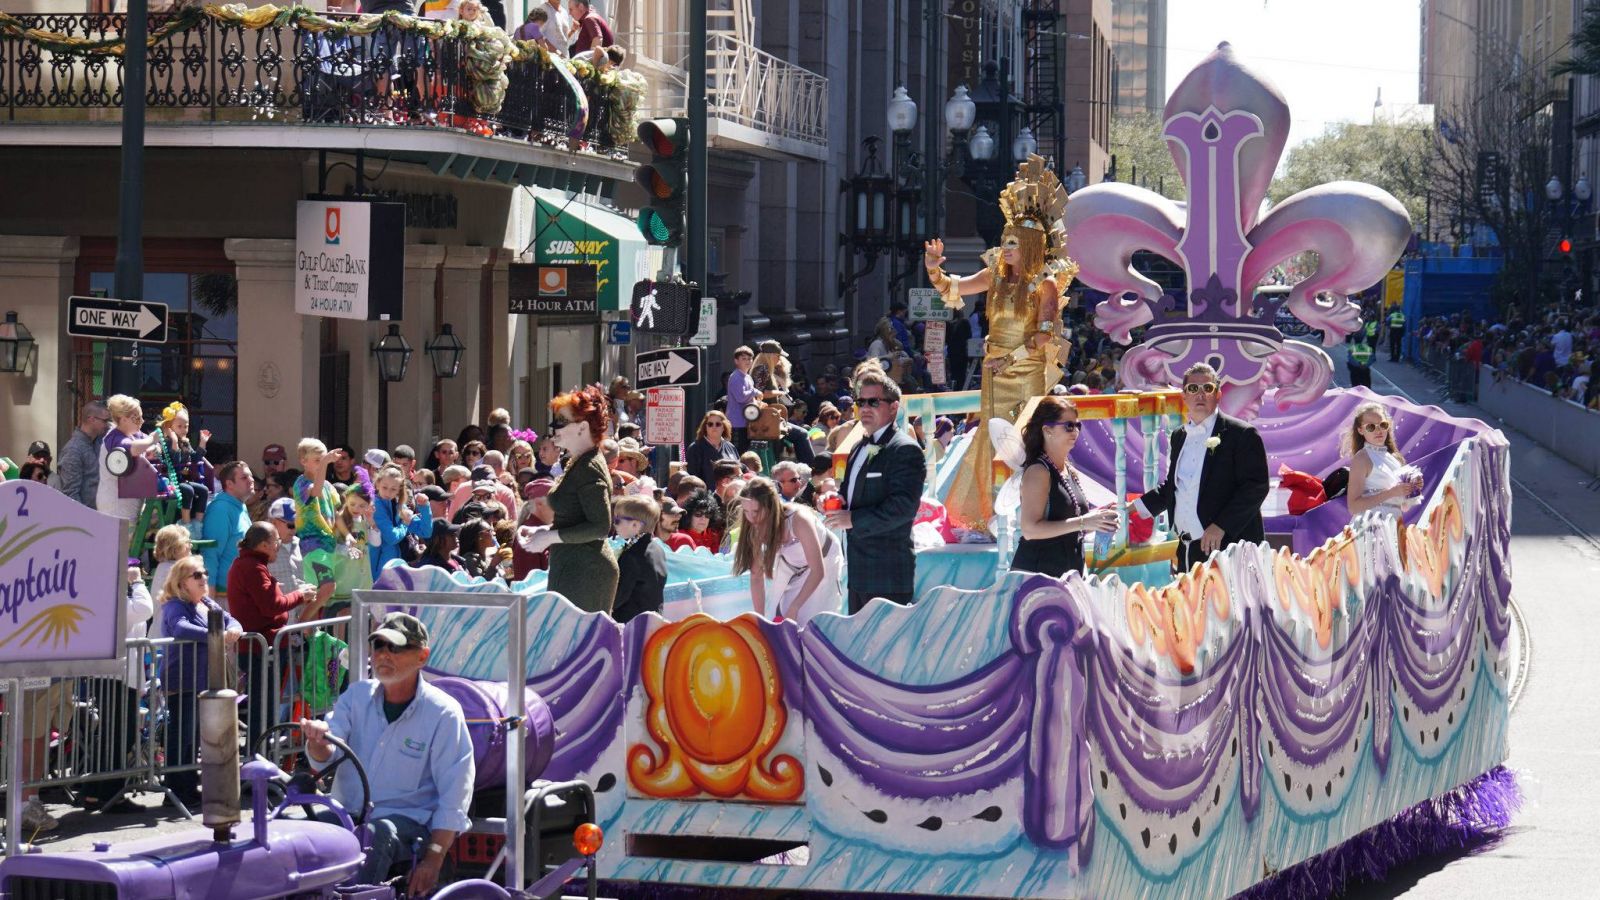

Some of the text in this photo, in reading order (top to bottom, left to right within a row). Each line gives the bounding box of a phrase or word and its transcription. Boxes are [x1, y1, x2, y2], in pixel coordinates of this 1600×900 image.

[962, 0, 975, 79] OUISI
[545, 240, 609, 255] SUBWAY
[299, 251, 367, 274] GULF COAST BANK
[305, 274, 358, 298] & Trust Company
[311, 297, 352, 313] 24 HOUR ATM
[511, 300, 595, 311] 24 HOUR ATM
[917, 297, 922, 305] 2
[80, 309, 138, 327] ONE WAY
[640, 361, 669, 379] ONE WAY
[648, 392, 682, 403] NO PARKING
[15, 486, 29, 517] 2
[0, 549, 79, 624] aptain
